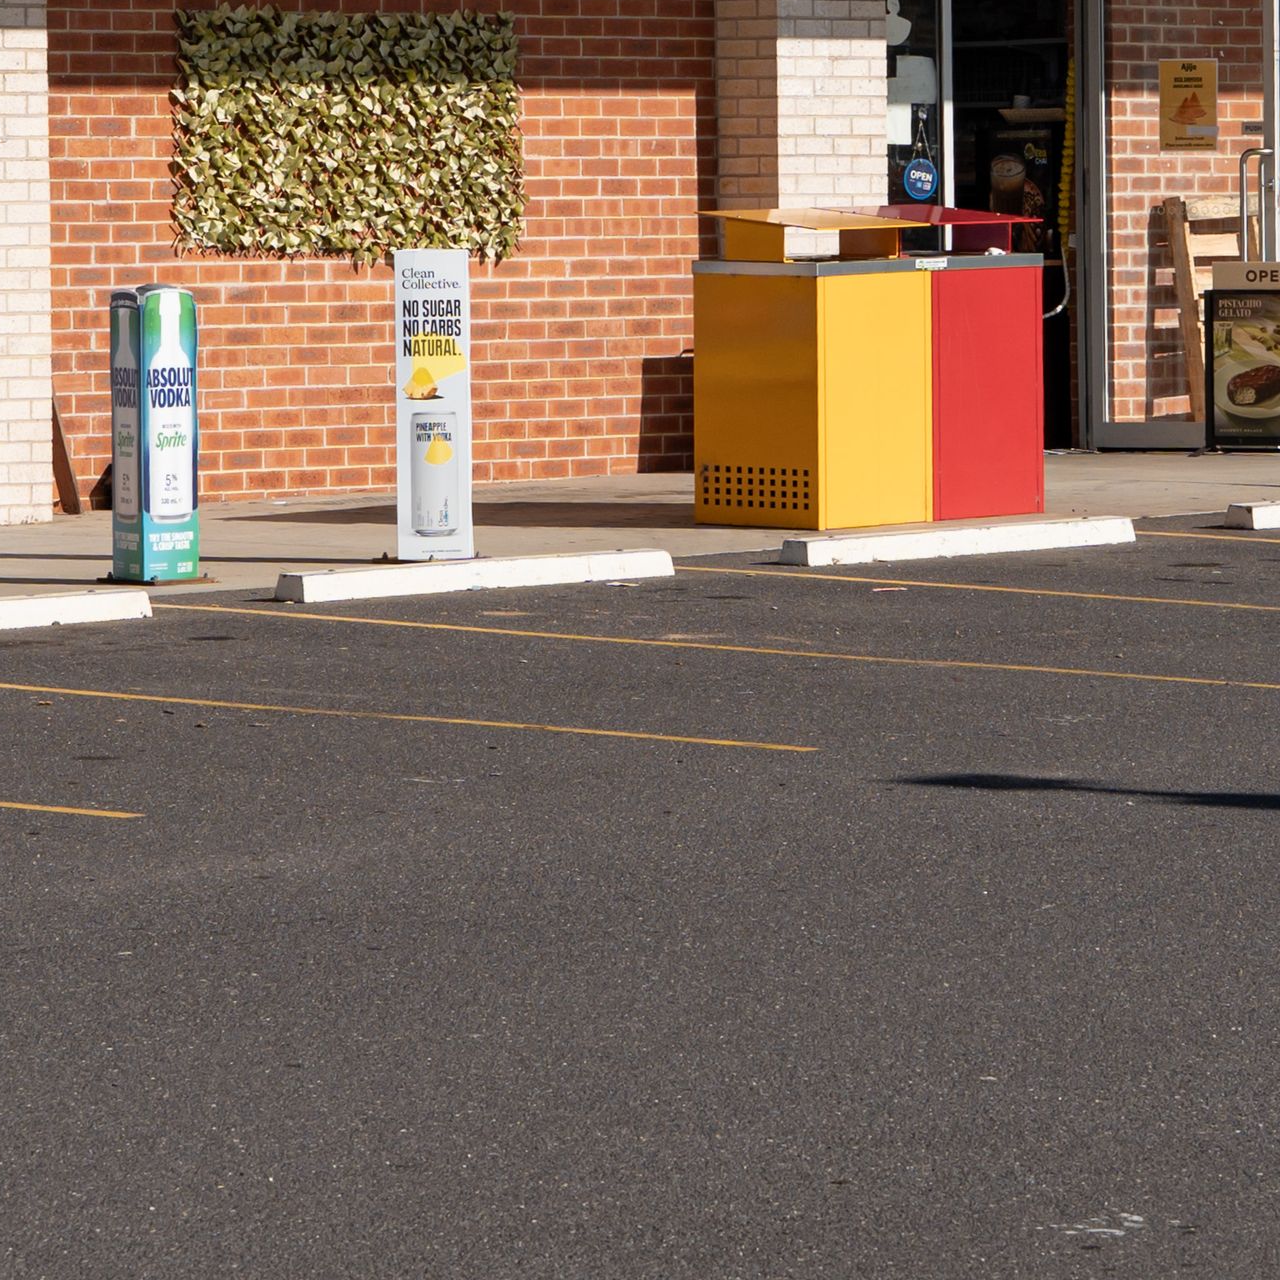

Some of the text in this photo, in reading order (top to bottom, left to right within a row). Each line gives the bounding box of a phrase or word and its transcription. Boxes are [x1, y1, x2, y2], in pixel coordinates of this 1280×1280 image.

[910, 170, 933, 182] OPEN
[402, 267, 435, 279] Clean
[402, 299, 461, 318] NO SUGAR
[1218, 299, 1262, 308] PISTACHIO
[1218, 309, 1252, 318] GELATO
[402, 318, 461, 337] NO CARBS
[403, 339, 462, 357] NATURAL.
[146, 367, 194, 389] ABSOLUT
[113, 387, 138, 409] VODKA
[150, 387, 191, 408] VODKA
[415, 422, 447, 432] PINEAPPLE
[155, 431, 187, 451] Sprite
[415, 431, 452, 442] WITH VODKA
